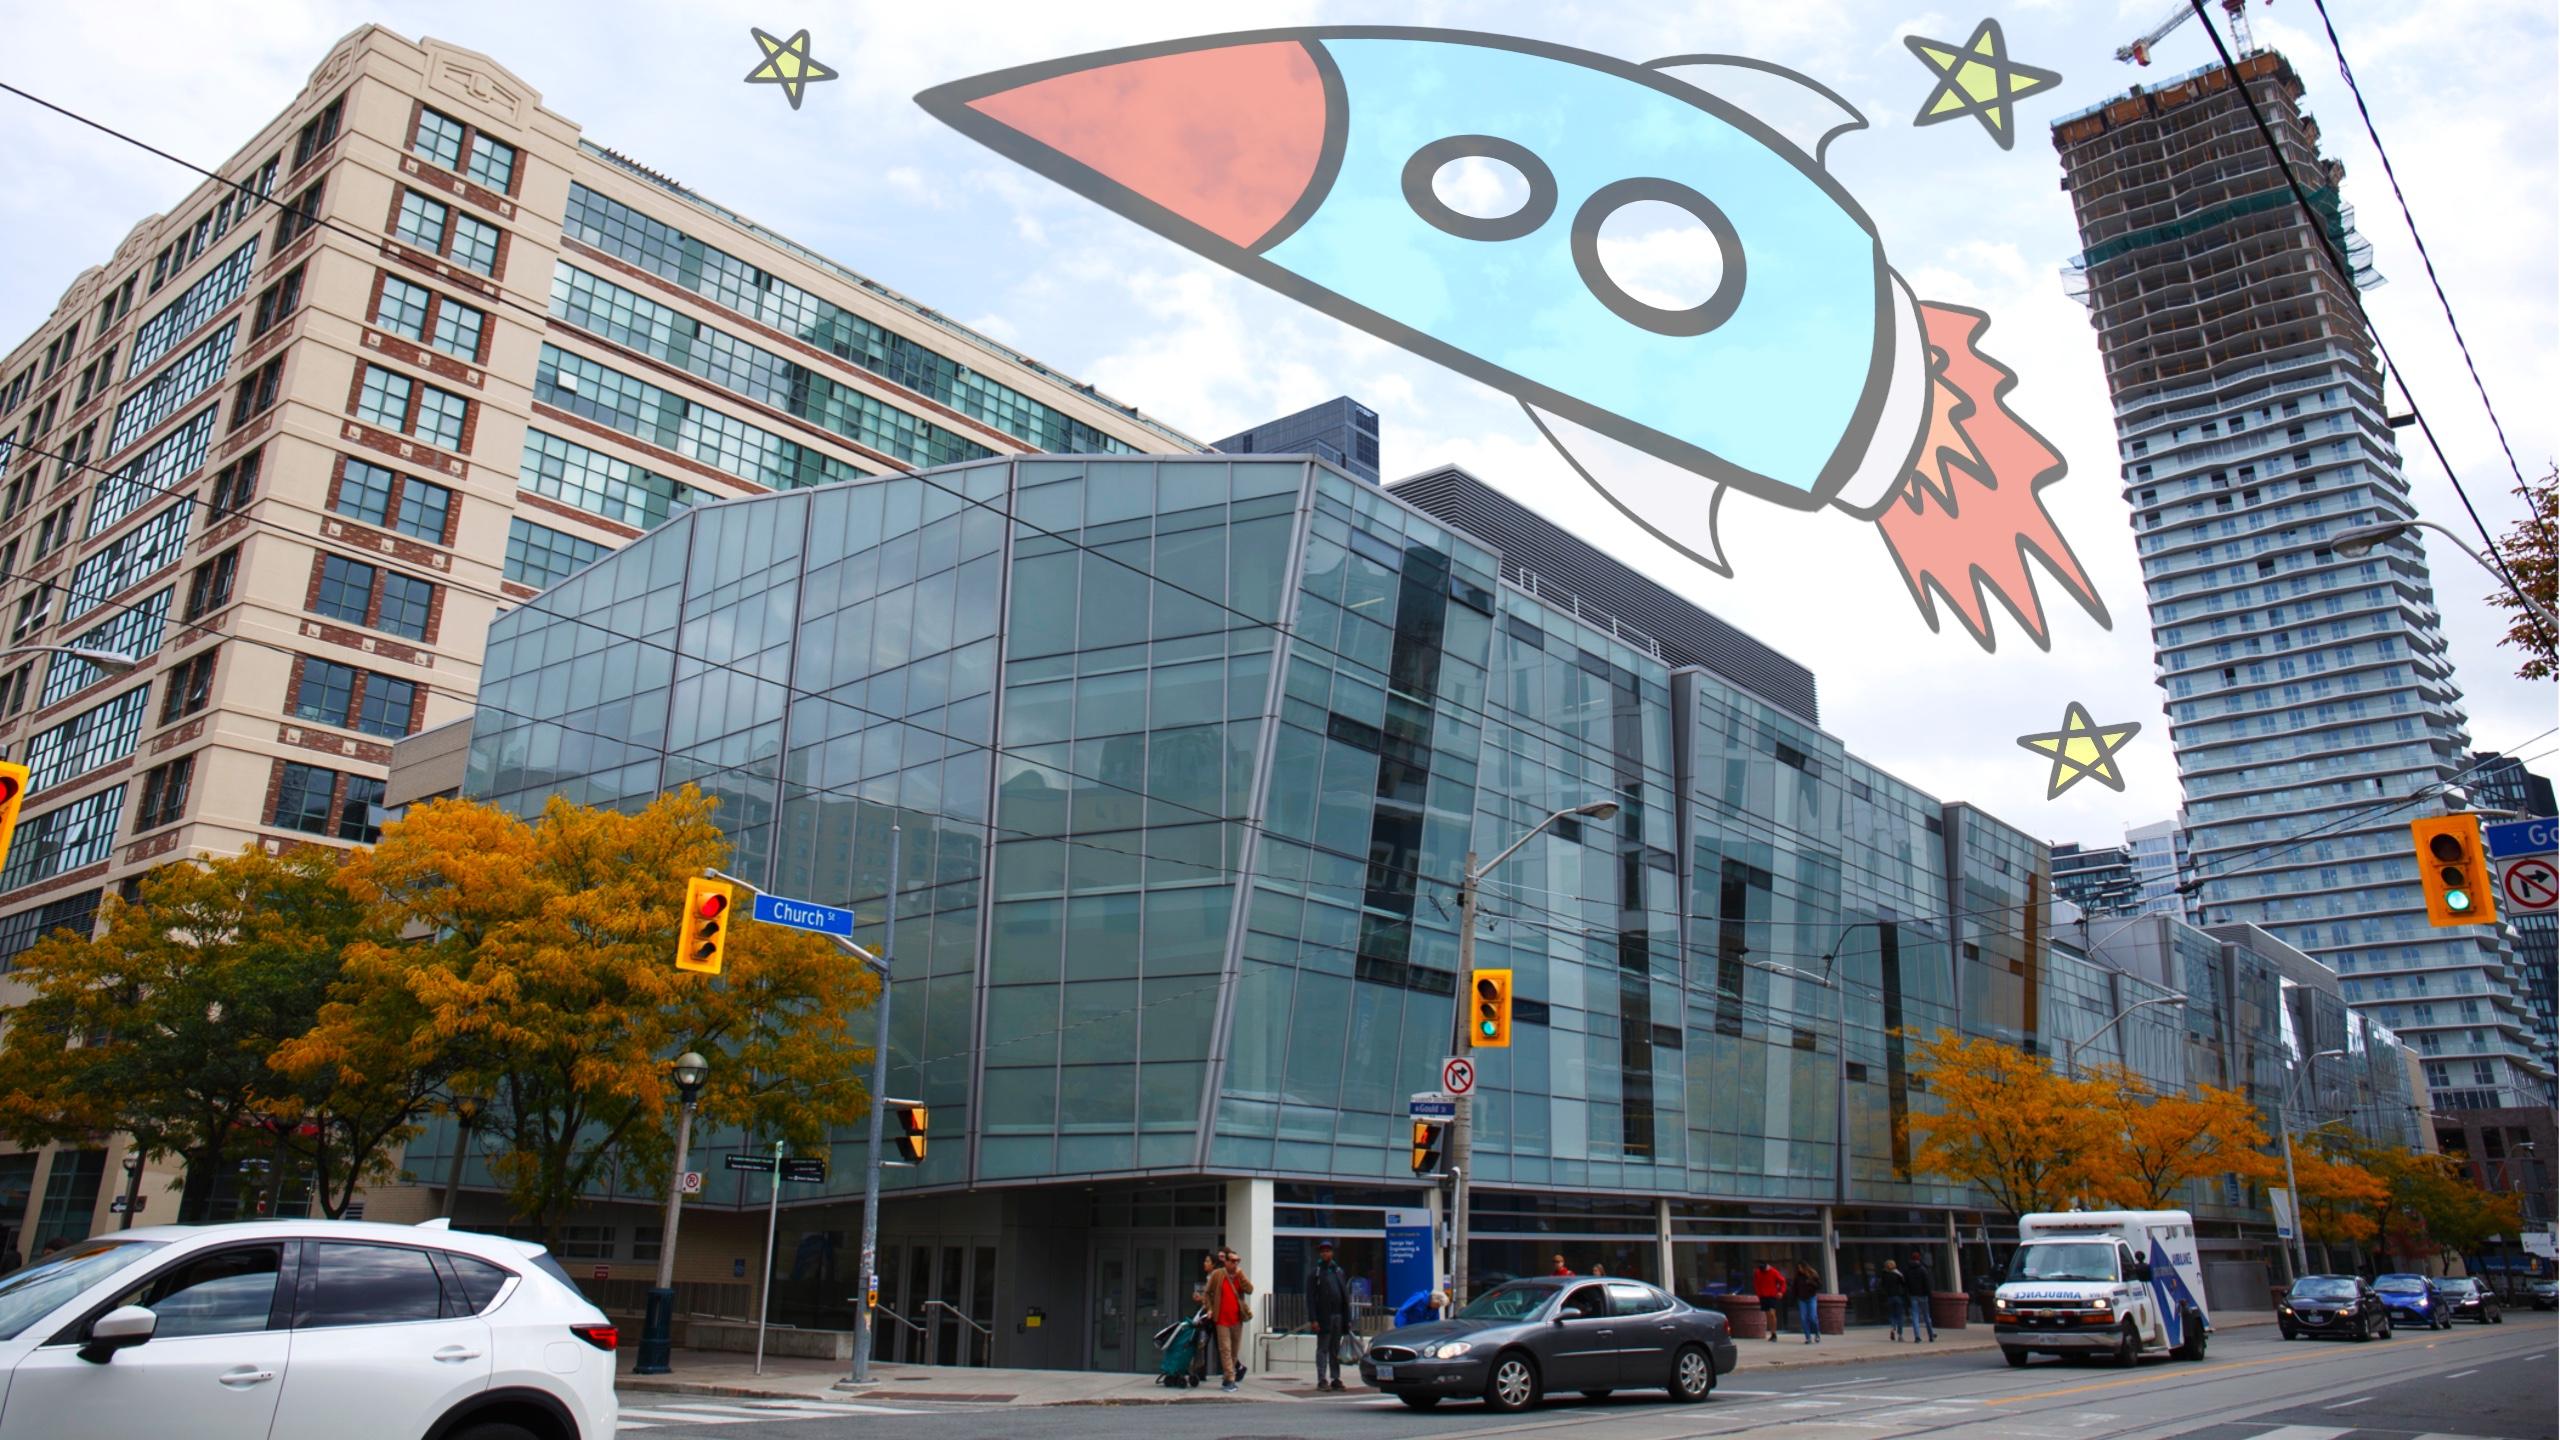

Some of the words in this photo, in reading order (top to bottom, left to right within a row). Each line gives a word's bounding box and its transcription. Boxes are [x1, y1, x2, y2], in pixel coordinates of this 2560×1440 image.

[773, 902, 824, 927] Church
[828, 911, 836, 922] St
[1419, 1104, 1439, 1113] Gould
